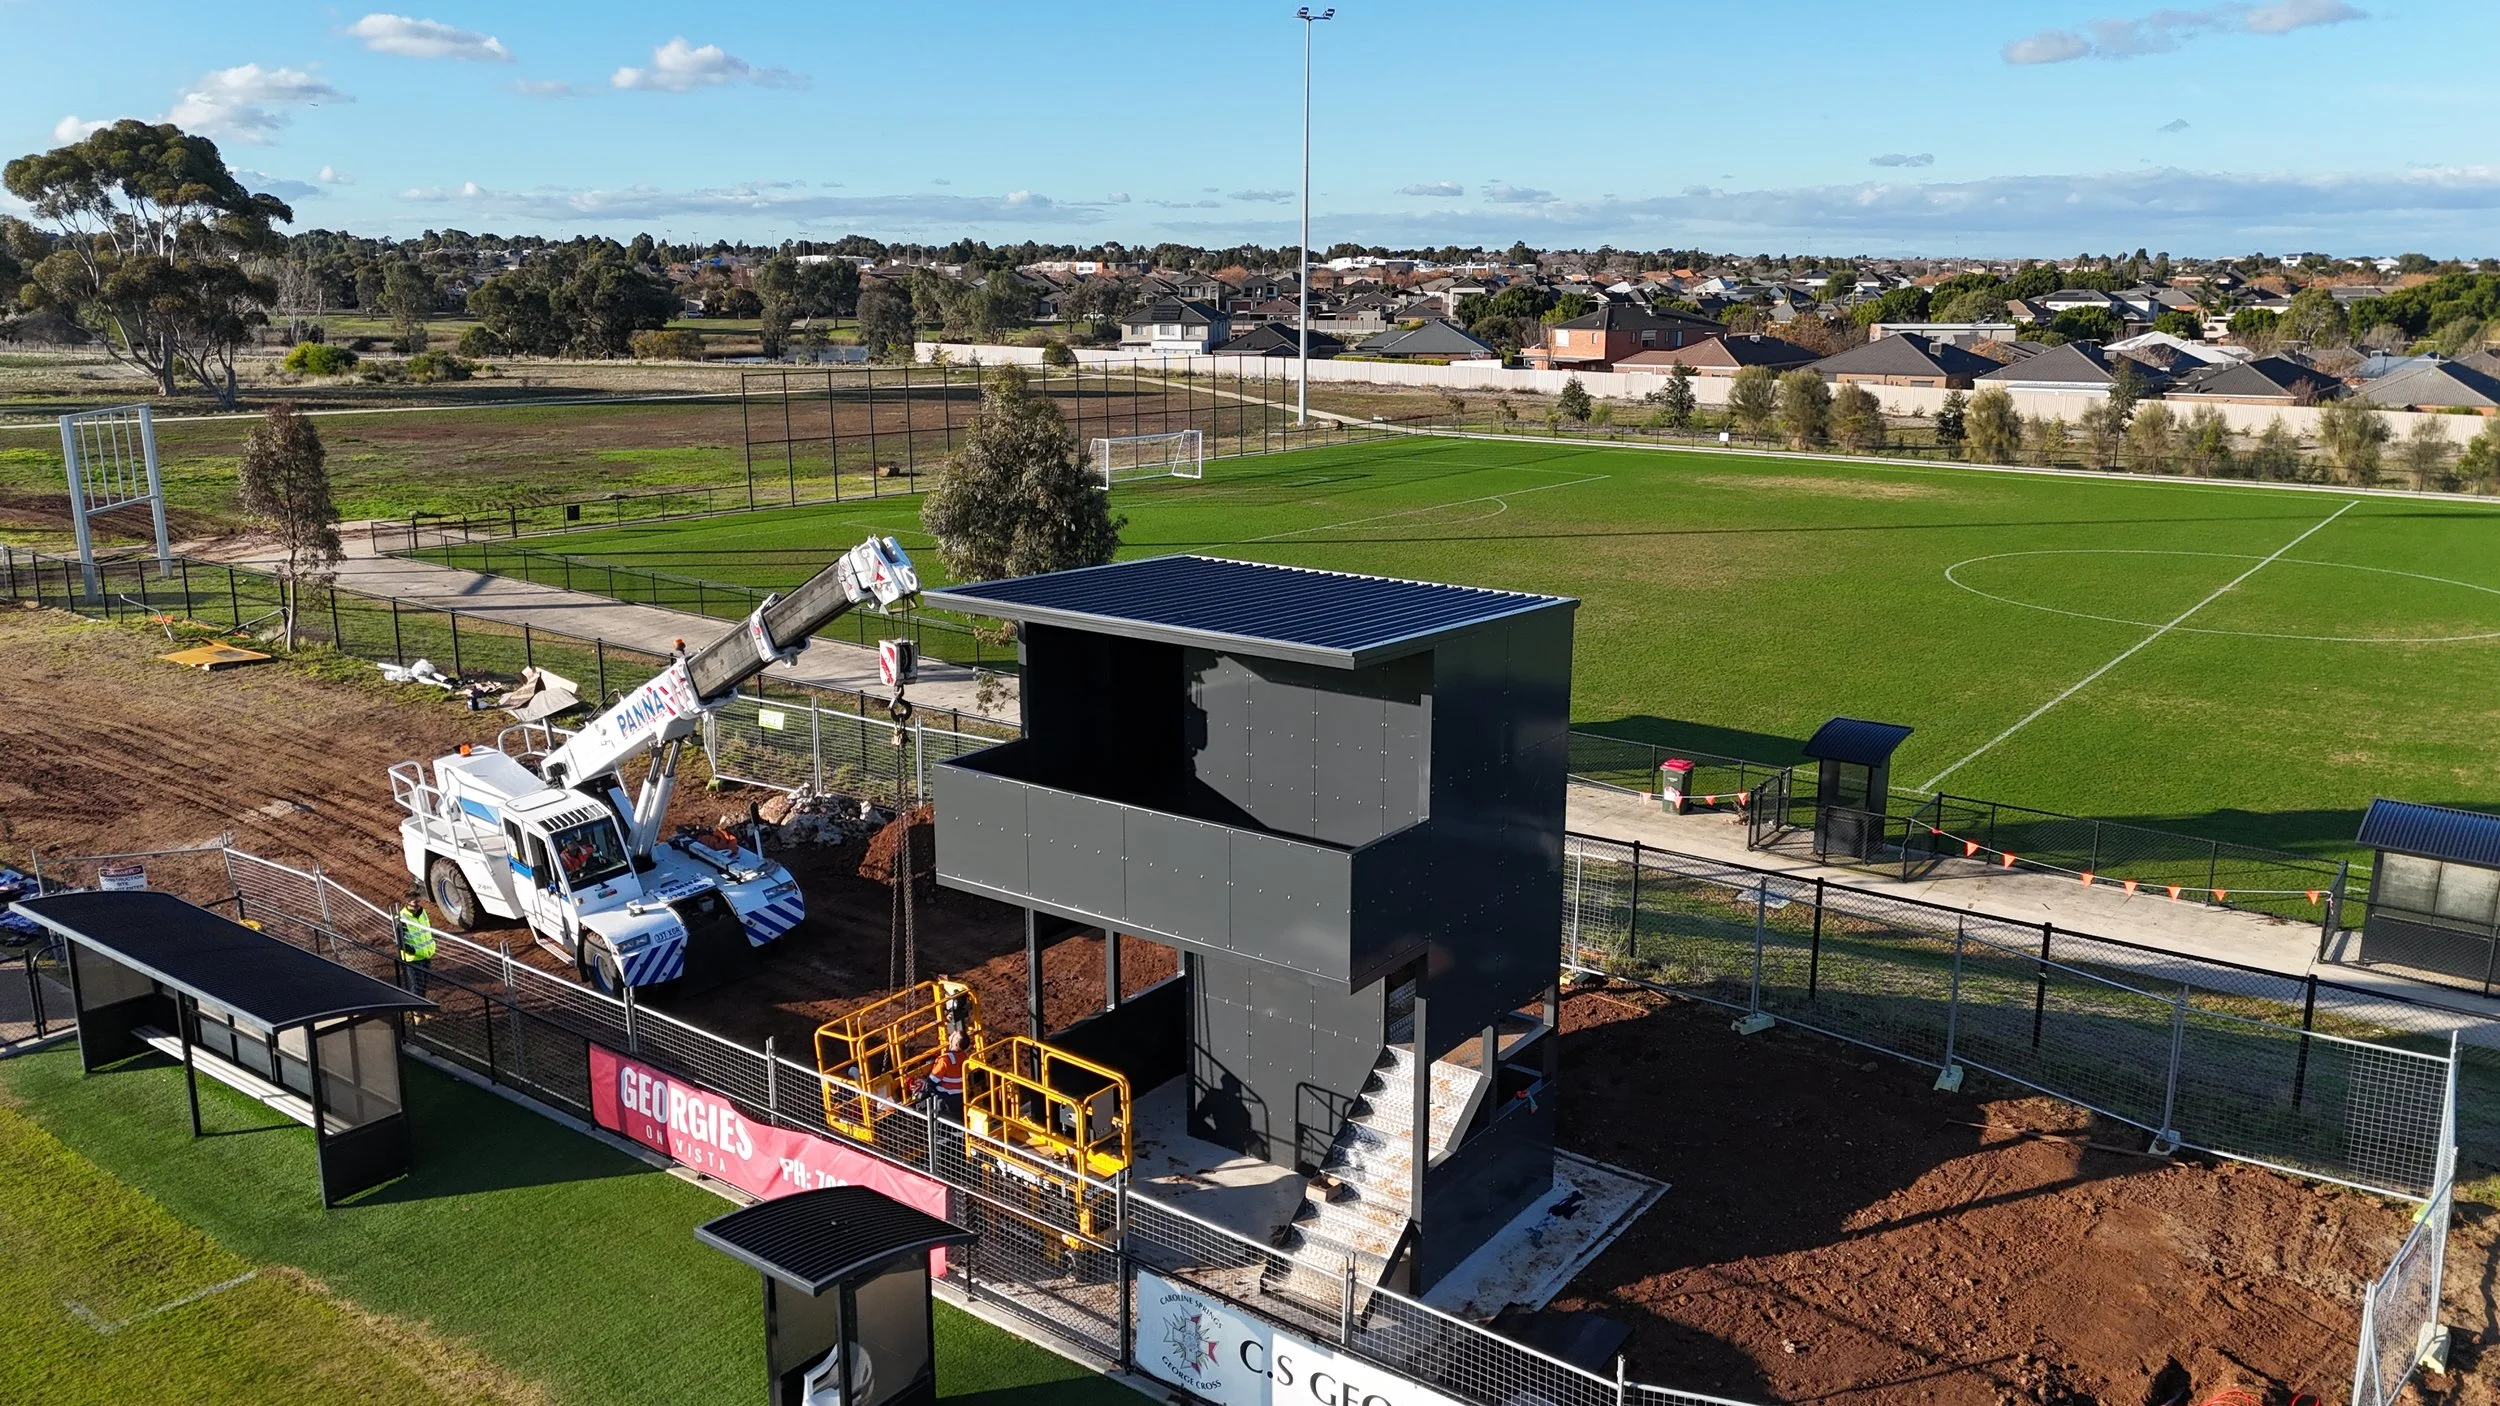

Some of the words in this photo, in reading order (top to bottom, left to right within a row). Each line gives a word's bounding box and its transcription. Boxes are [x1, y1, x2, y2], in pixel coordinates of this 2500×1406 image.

[616, 690, 665, 737] PANNA
[620, 1066, 753, 1161] GEORGIES
[646, 1124, 664, 1146] ON
[676, 1138, 727, 1173] VISTA
[779, 1157, 811, 1190] PH:
[1160, 1293, 1194, 1305] CAROLINE
[1195, 1300, 1223, 1329] SPRINGS
[1161, 1356, 1194, 1386] GEORGE
[1195, 1380, 1222, 1391] CROSS
[1239, 1340, 1294, 1386] C.S
